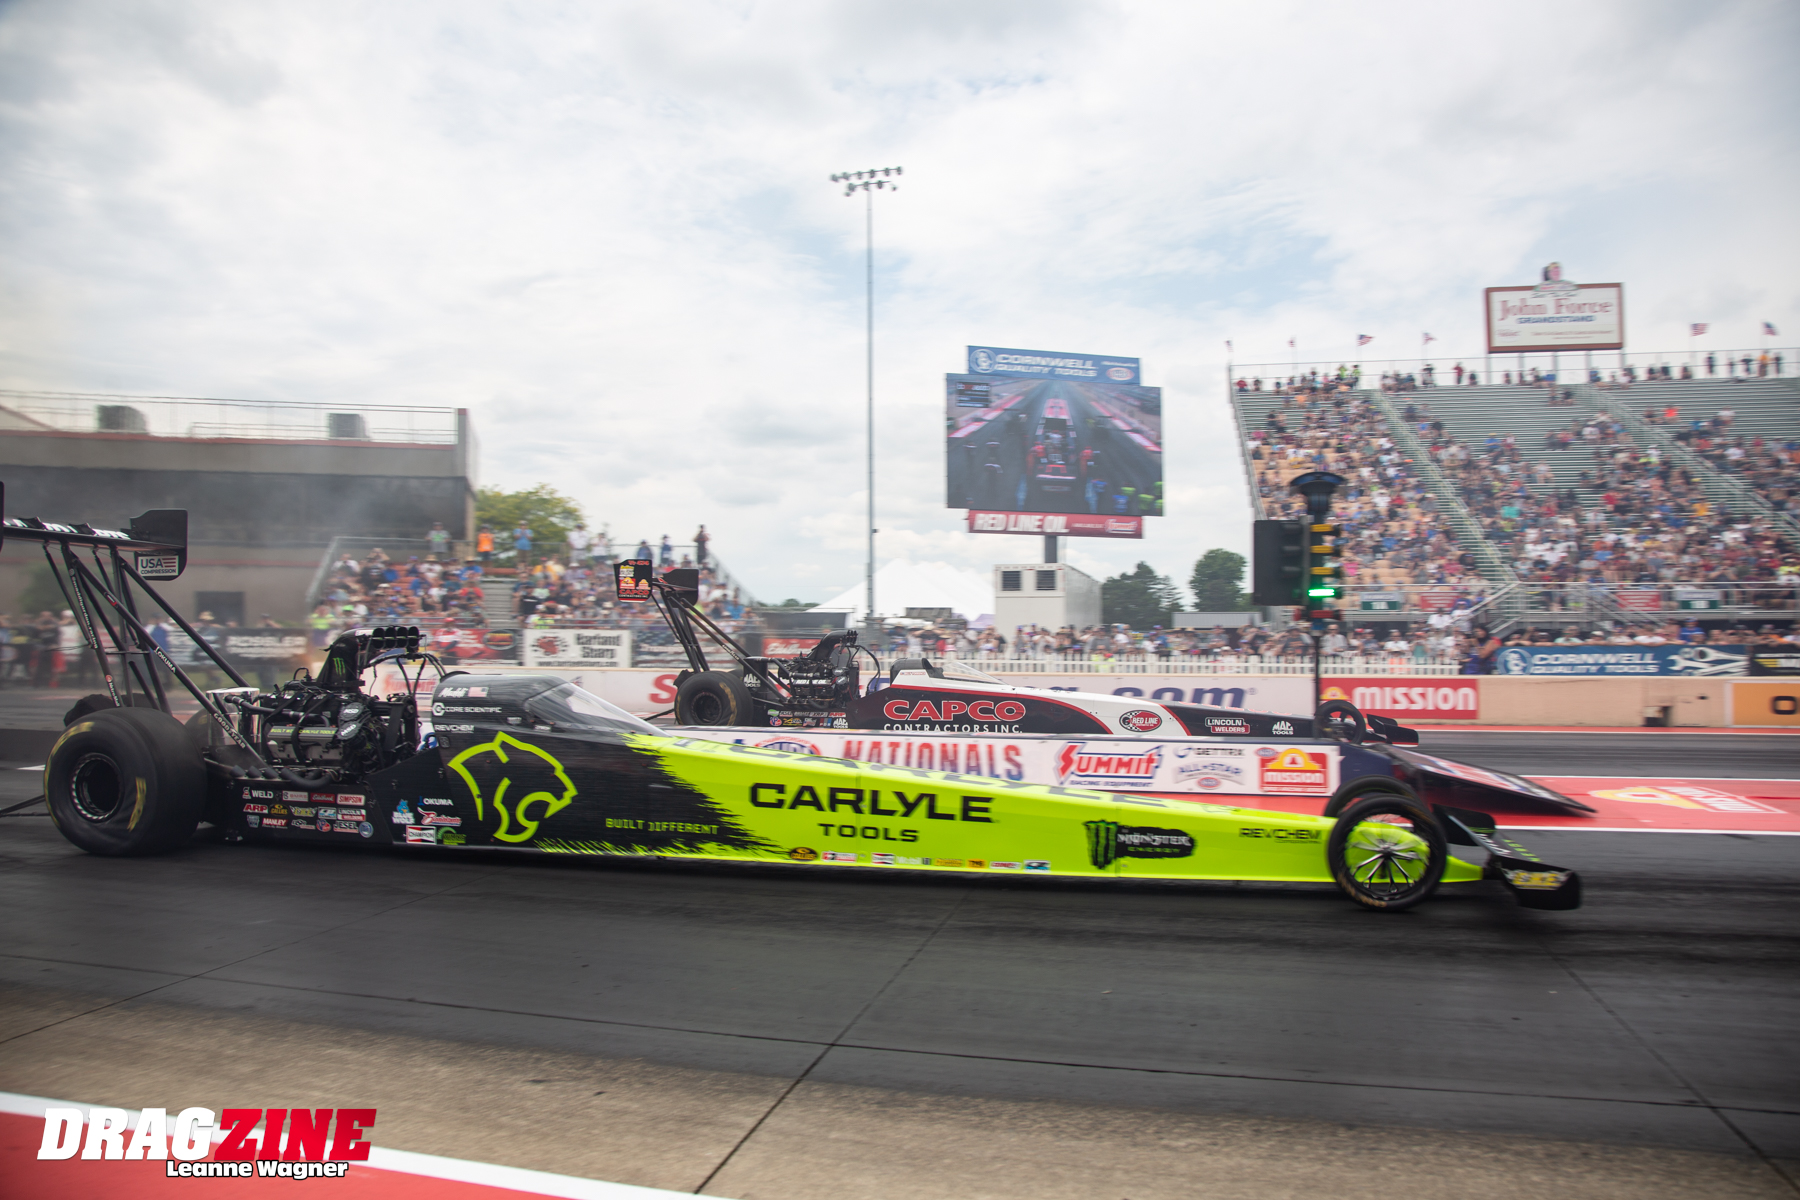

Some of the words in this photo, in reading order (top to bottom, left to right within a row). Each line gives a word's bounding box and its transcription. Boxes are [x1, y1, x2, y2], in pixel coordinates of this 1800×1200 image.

[1498, 298, 1547, 321] John
[1553, 298, 1614, 314] Force
[995, 353, 1098, 369] CORNWELL
[1054, 367, 1097, 377] TOOLS
[973, 513, 1006, 531] RED
[1006, 514, 1044, 532] LINE
[1043, 515, 1070, 533] OIL
[140, 558, 163, 569] USA
[1531, 653, 1662, 665] CORNWELL
[1530, 665, 1601, 674] QUALITY
[1603, 664, 1660, 673] TOOLS
[883, 700, 1027, 722] CAPCO
[1207, 718, 1242, 726] LINCOLN
[1272, 720, 1293, 731] MAC
[883, 723, 990, 733] CONTRACTORS
[994, 724, 1023, 734] INC.
[841, 740, 1025, 781] NATIONALS
[1263, 772, 1324, 784] MISSION
[251, 789, 274, 799] WELD
[339, 795, 364, 804] SIMPSON
[422, 797, 454, 806] OKUMA
[748, 782, 995, 823] CARLYLE
[244, 804, 267, 813] ARP
[262, 817, 287, 826] MANLEY
[605, 817, 645, 829] BUILT
[647, 821, 720, 835] DIFFERENT
[817, 823, 920, 843] TOOLS
[1117, 832, 1192, 846] MONSTER
[1238, 827, 1322, 840] REVCHEM
